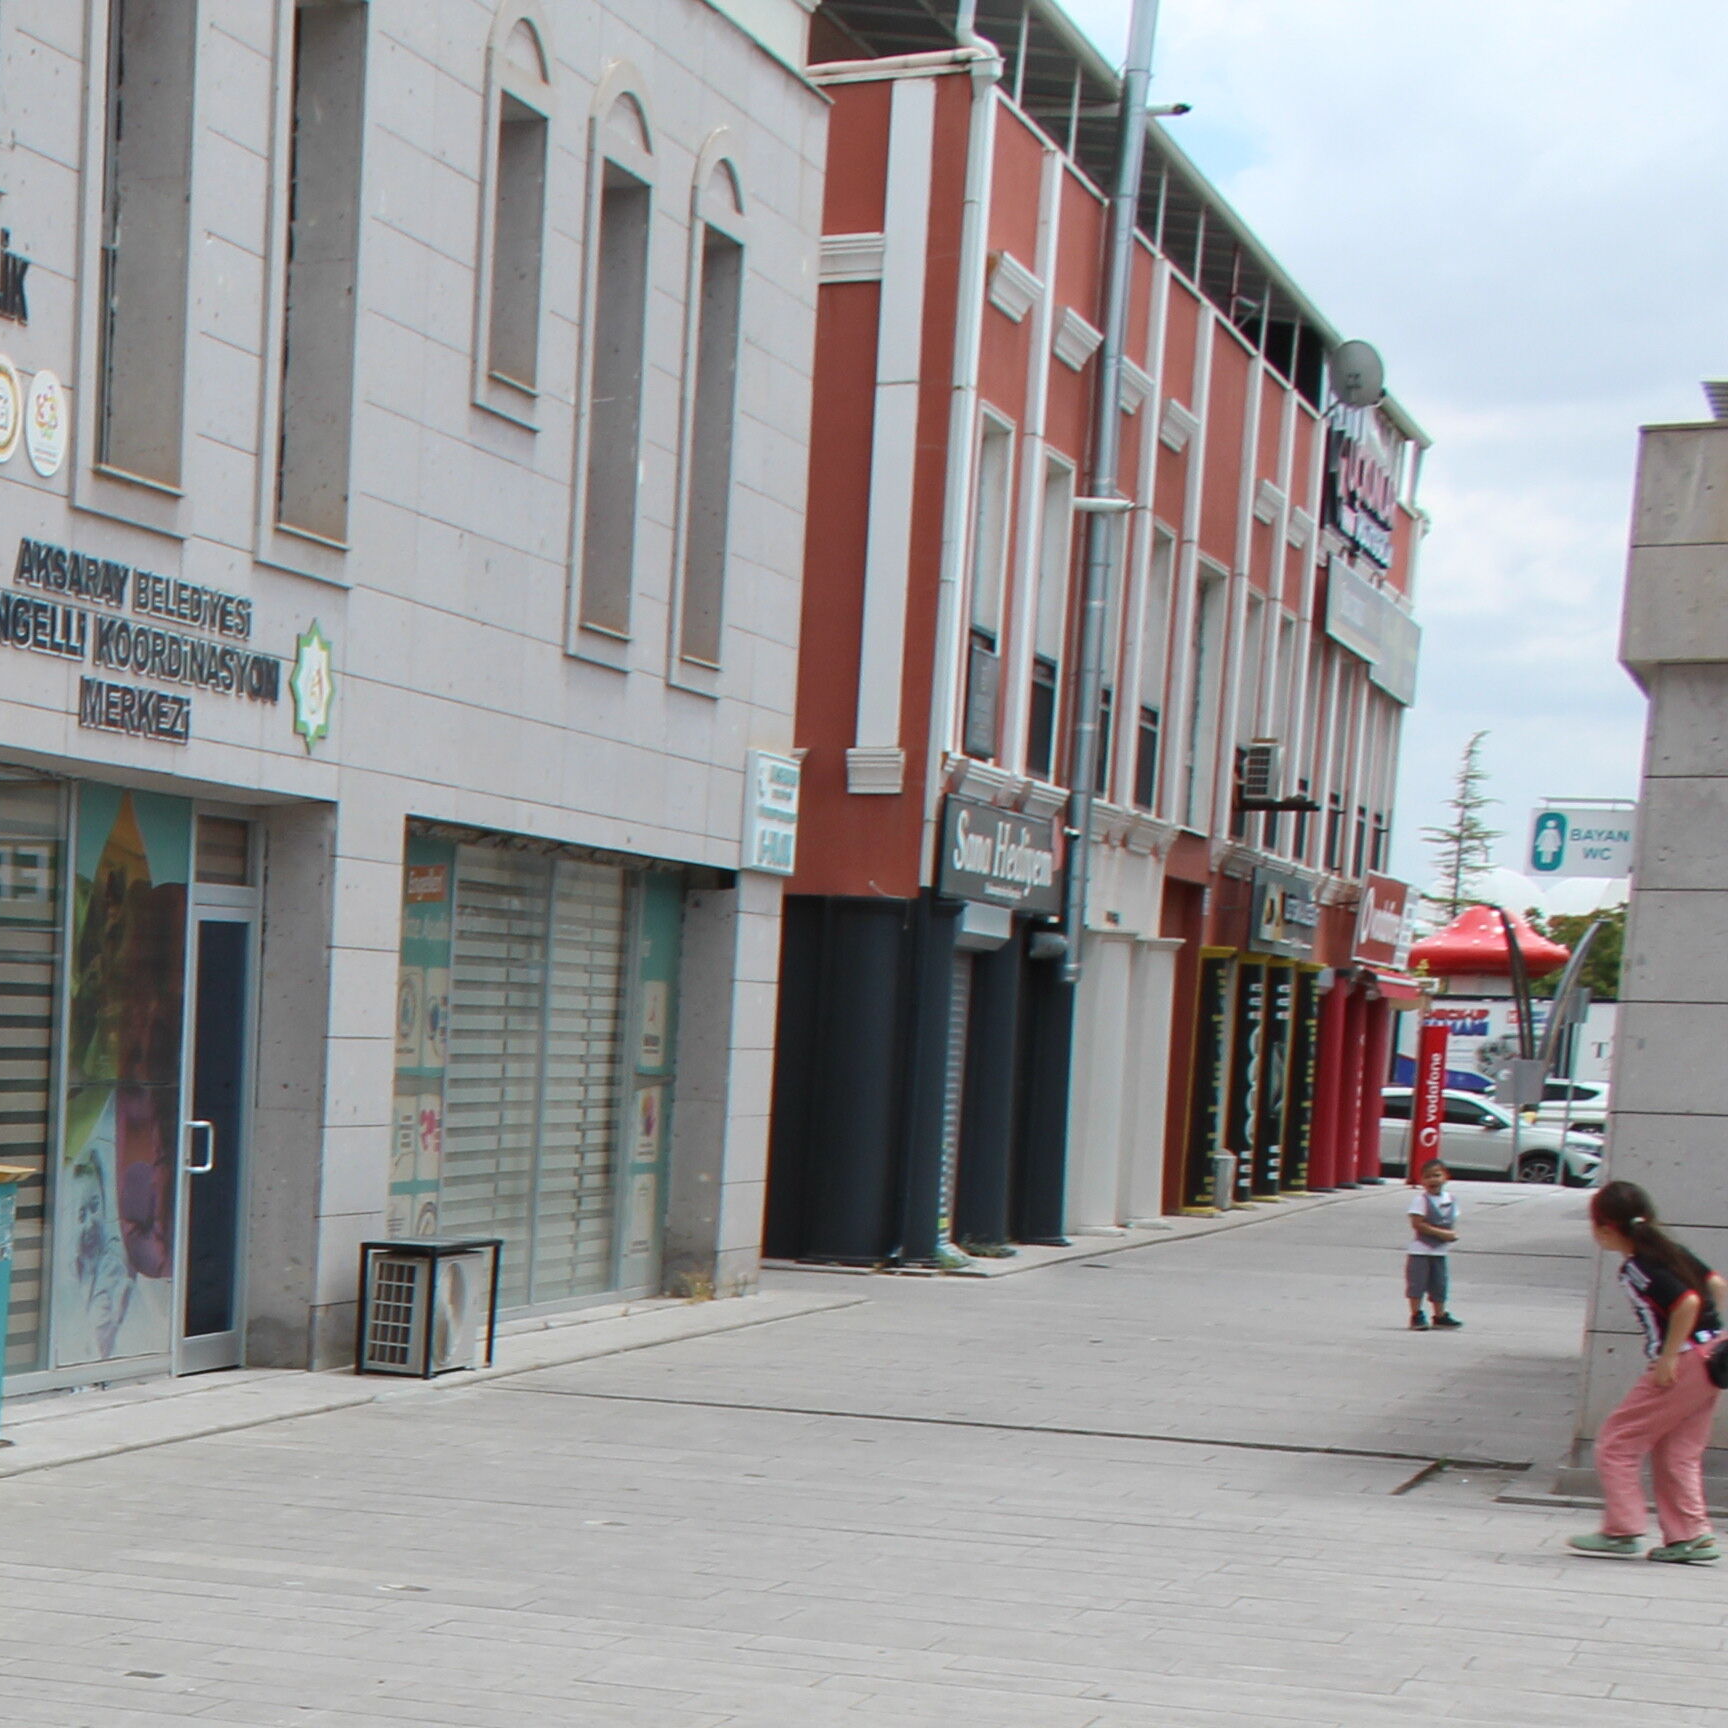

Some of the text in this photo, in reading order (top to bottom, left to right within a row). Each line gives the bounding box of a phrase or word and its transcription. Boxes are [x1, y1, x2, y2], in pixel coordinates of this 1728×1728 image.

[12, 537, 132, 608] AKSARAY
[1570, 828, 1630, 842] BAYAN
[1583, 847, 1612, 860] WC
[1426, 1052, 1443, 1123] vodafone
